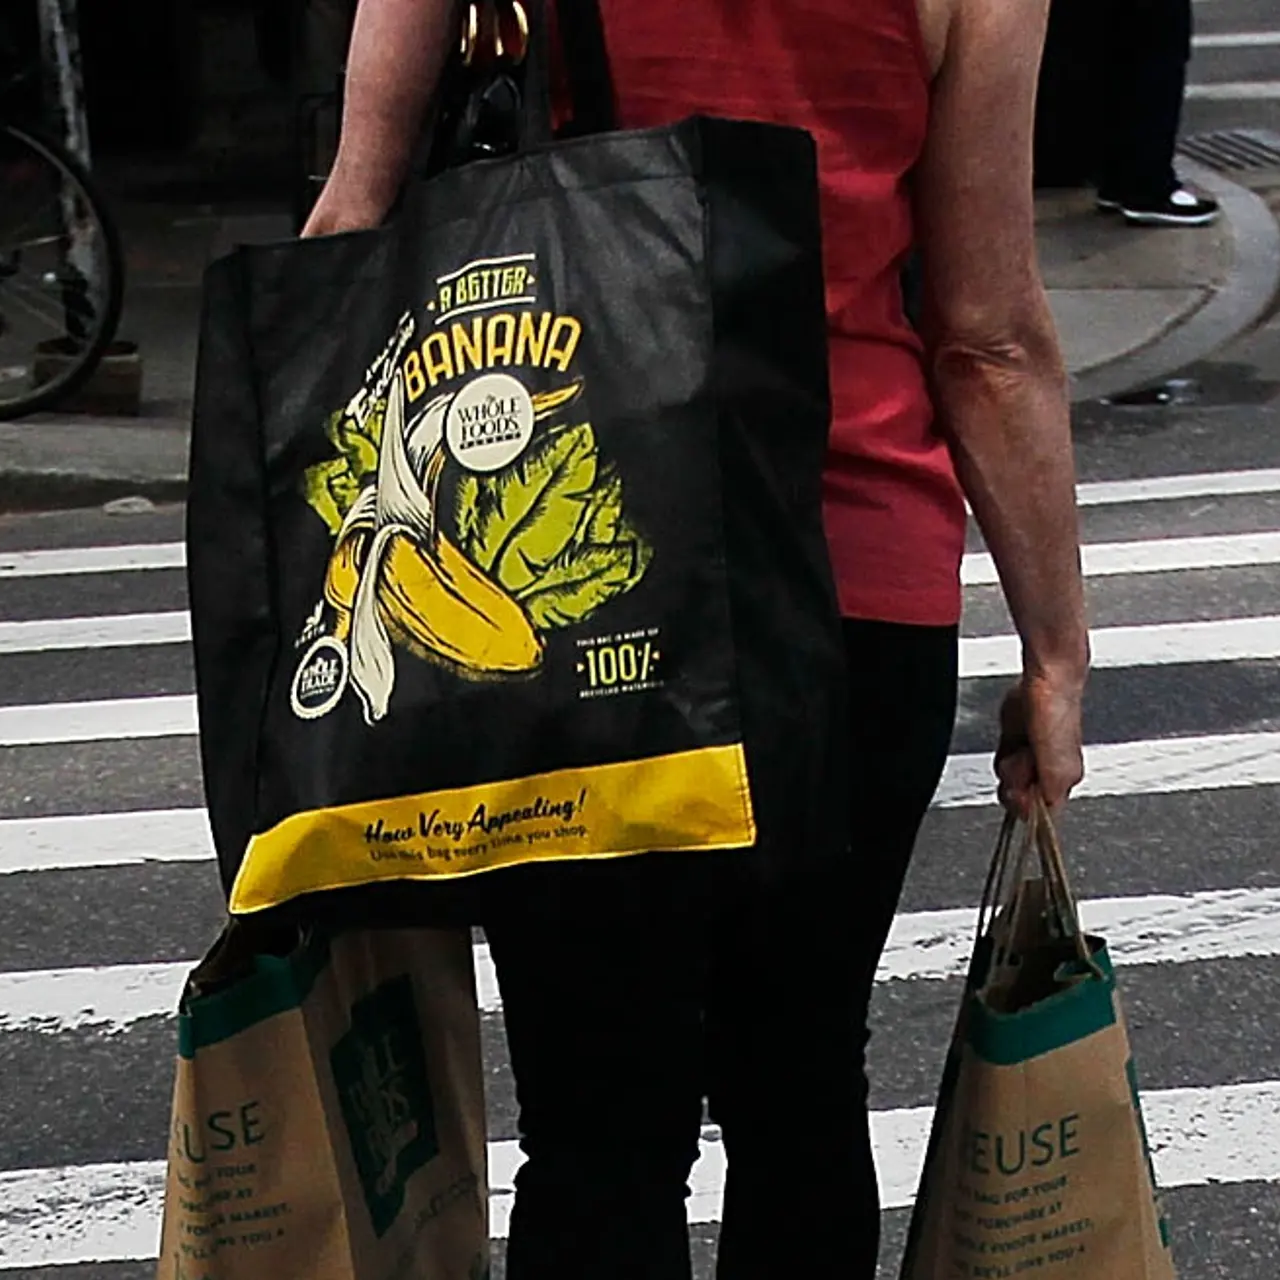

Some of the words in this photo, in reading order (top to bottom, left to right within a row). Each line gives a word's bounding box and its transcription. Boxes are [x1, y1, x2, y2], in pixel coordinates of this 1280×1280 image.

[439, 286, 452, 312] A
[456, 266, 528, 306] BETTER
[403, 312, 581, 403] BANANA
[457, 396, 522, 423] WHOLE
[462, 415, 520, 442] FOODS
[586, 642, 655, 687] 100%
[363, 819, 416, 844] How
[419, 809, 464, 842] Very
[467, 788, 587, 834] Appealing!
[526, 831, 551, 844] you
